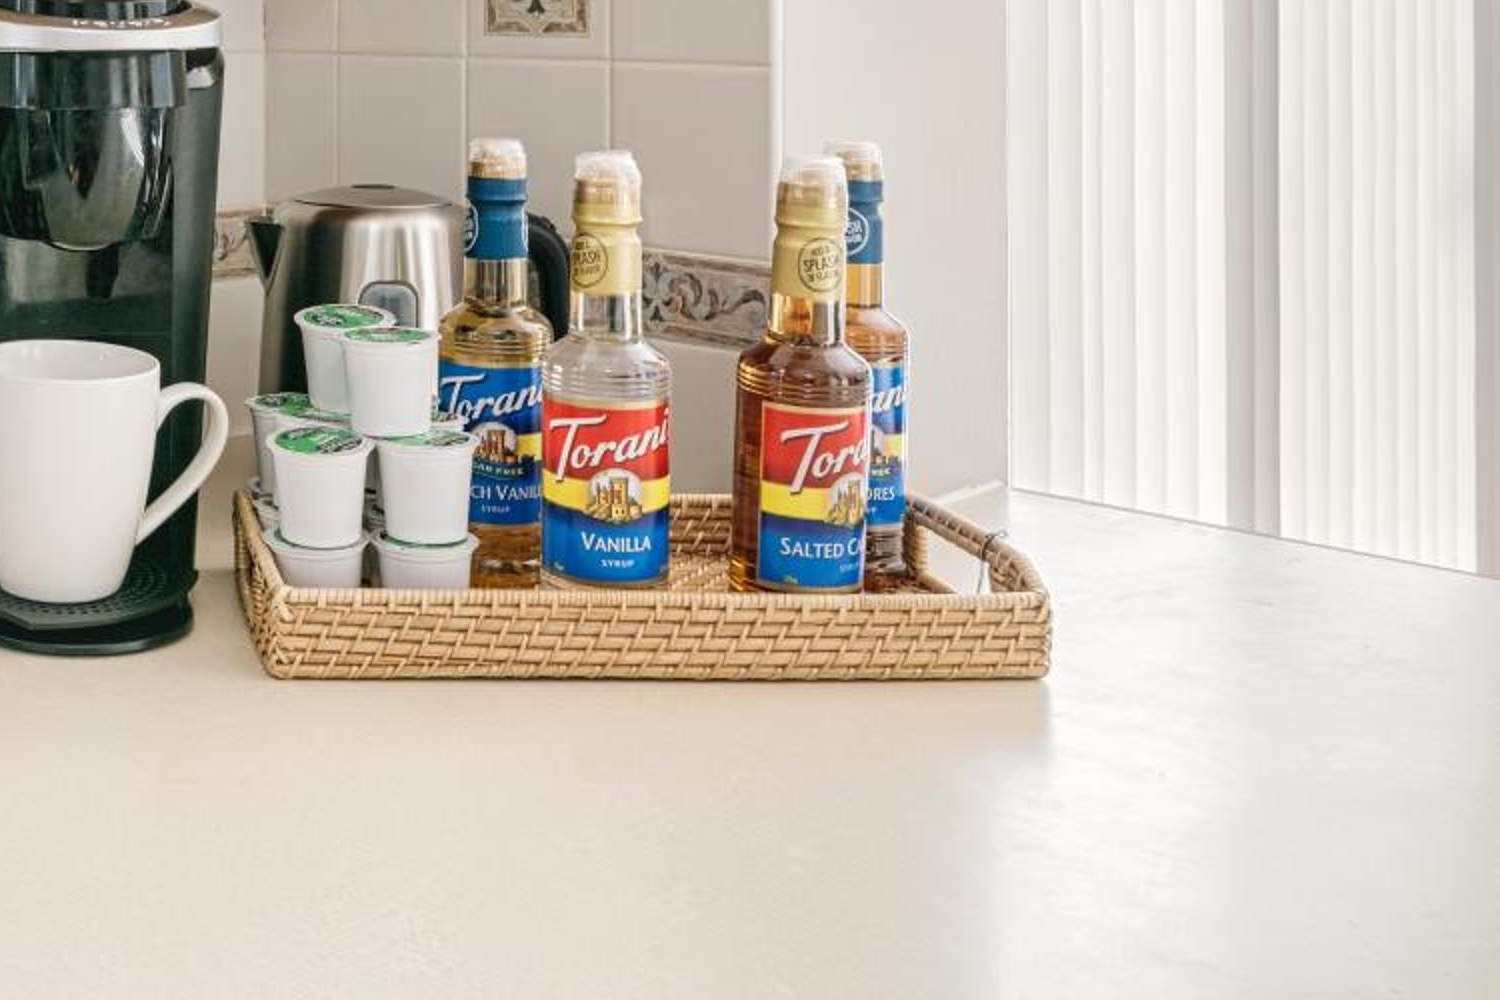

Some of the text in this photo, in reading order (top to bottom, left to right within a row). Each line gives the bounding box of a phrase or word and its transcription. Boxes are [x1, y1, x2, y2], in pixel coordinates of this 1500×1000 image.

[550, 408, 669, 483] Torani
[780, 420, 868, 496] Tora
[581, 531, 652, 553] VANILLA
[780, 536, 843, 560] SALTED
[600, 558, 635, 568] SYRUP
